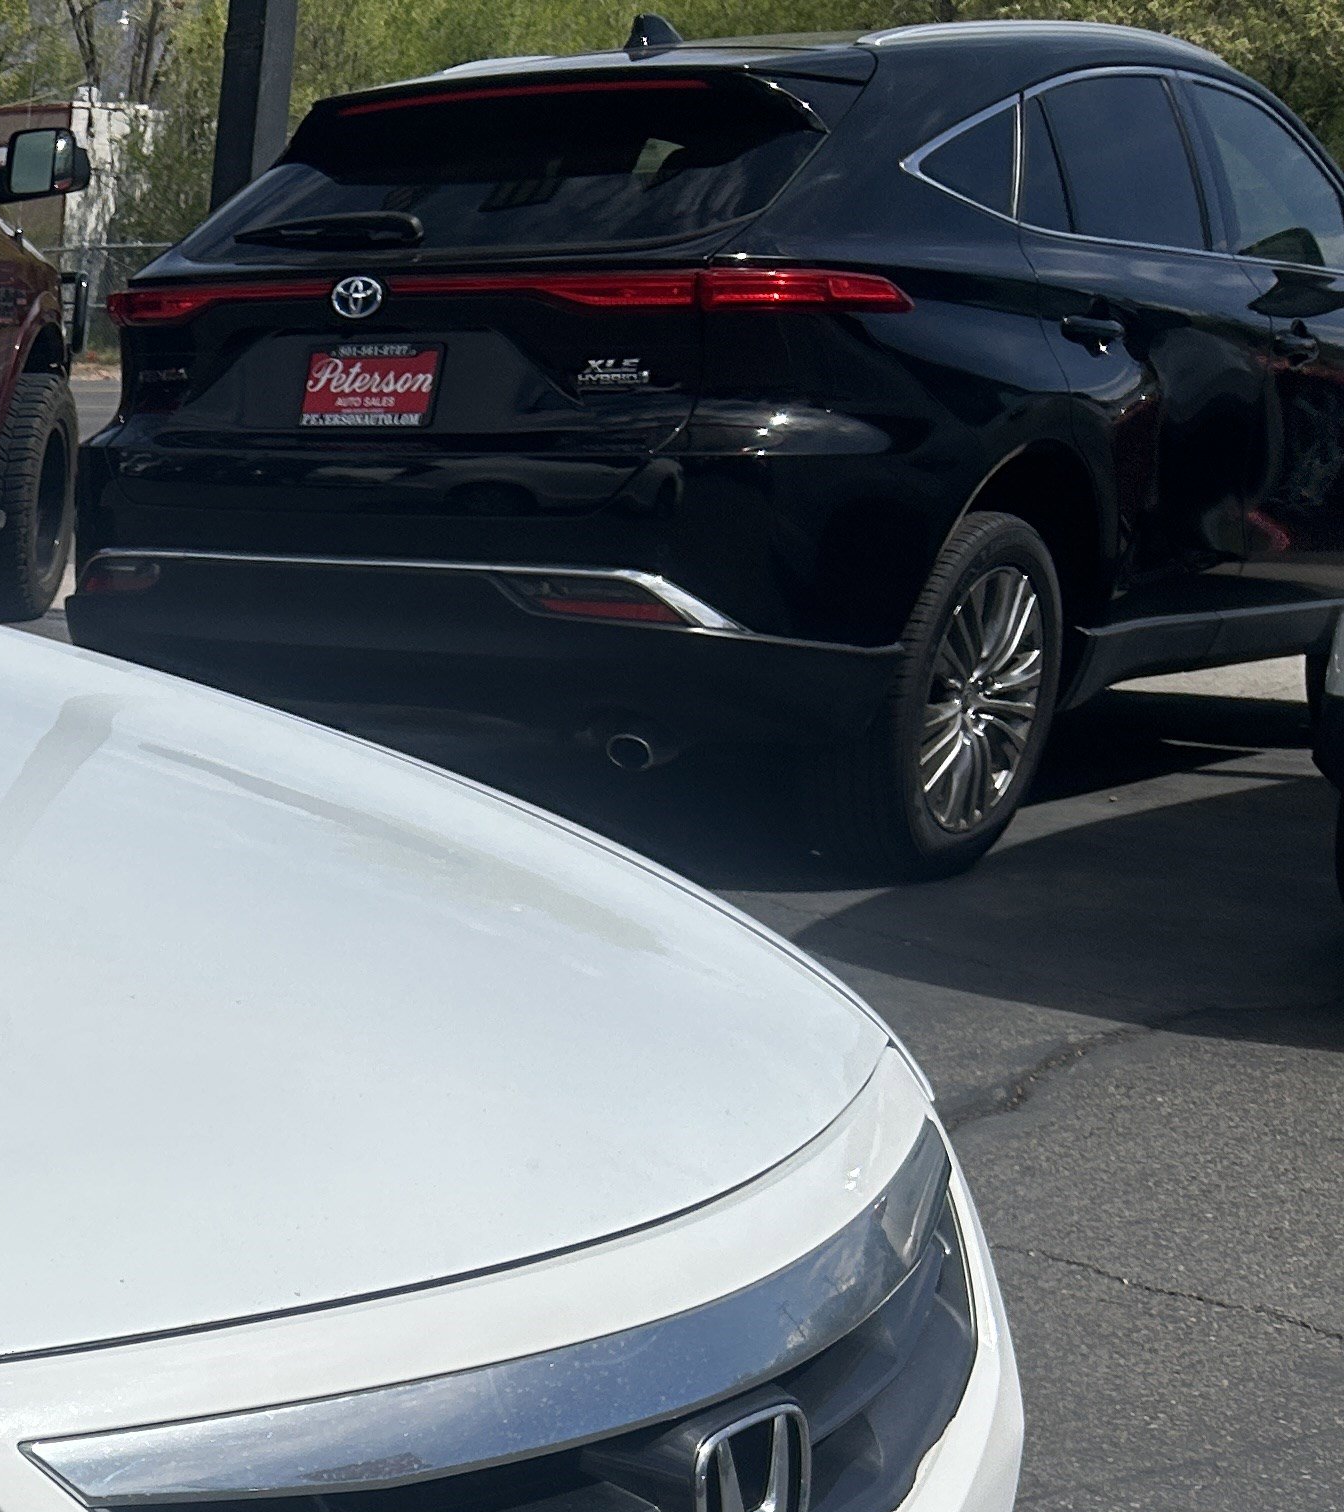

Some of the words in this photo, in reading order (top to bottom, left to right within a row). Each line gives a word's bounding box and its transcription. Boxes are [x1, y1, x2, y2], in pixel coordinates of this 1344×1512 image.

[305, 357, 434, 394] Peterson
[334, 396, 362, 407] AUTO
[363, 396, 396, 407] SALES
